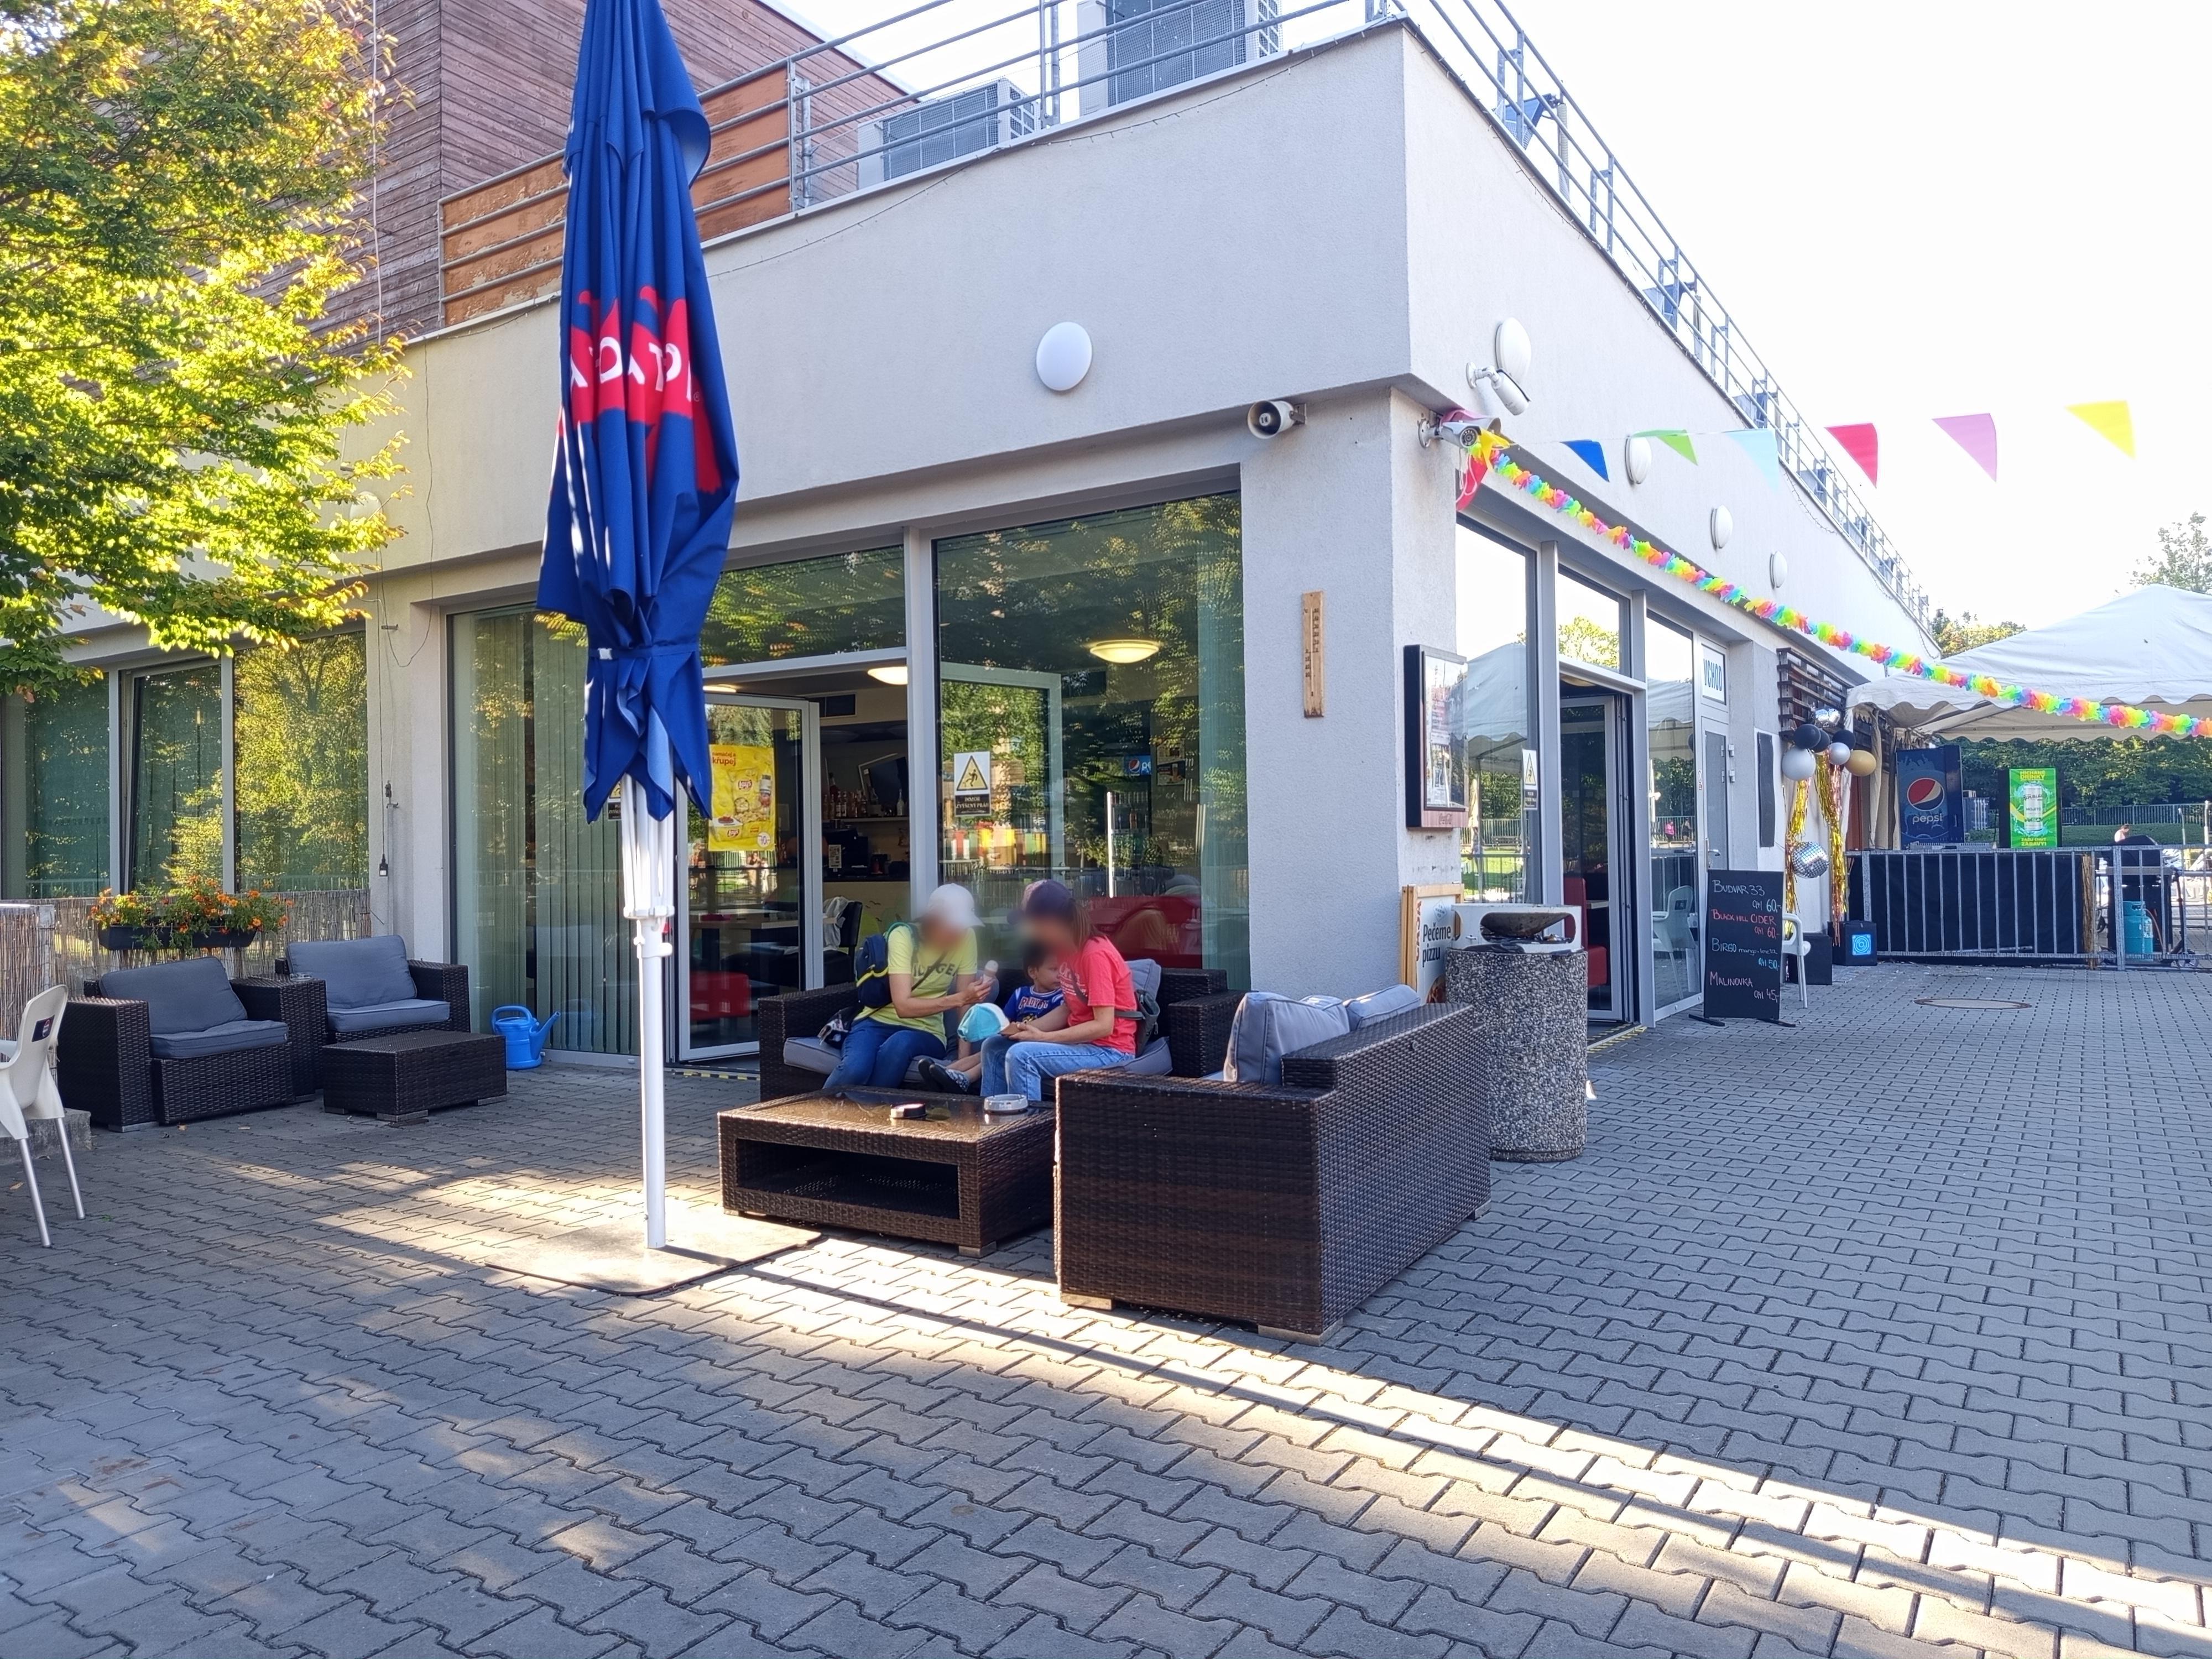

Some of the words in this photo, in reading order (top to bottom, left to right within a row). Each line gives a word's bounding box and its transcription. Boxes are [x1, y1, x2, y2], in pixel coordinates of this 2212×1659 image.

[1703, 659, 1722, 691] VCHOD
[712, 757, 736, 766] křupej
[1912, 813, 1942, 825] pepsi
[1749, 885, 1765, 896] 33
[1750, 914, 1777, 926] CIDER
[1422, 922, 1451, 942] Pečeme
[1422, 943, 1441, 968] pizzu
[1710, 971, 1753, 988] MALINOVKA
